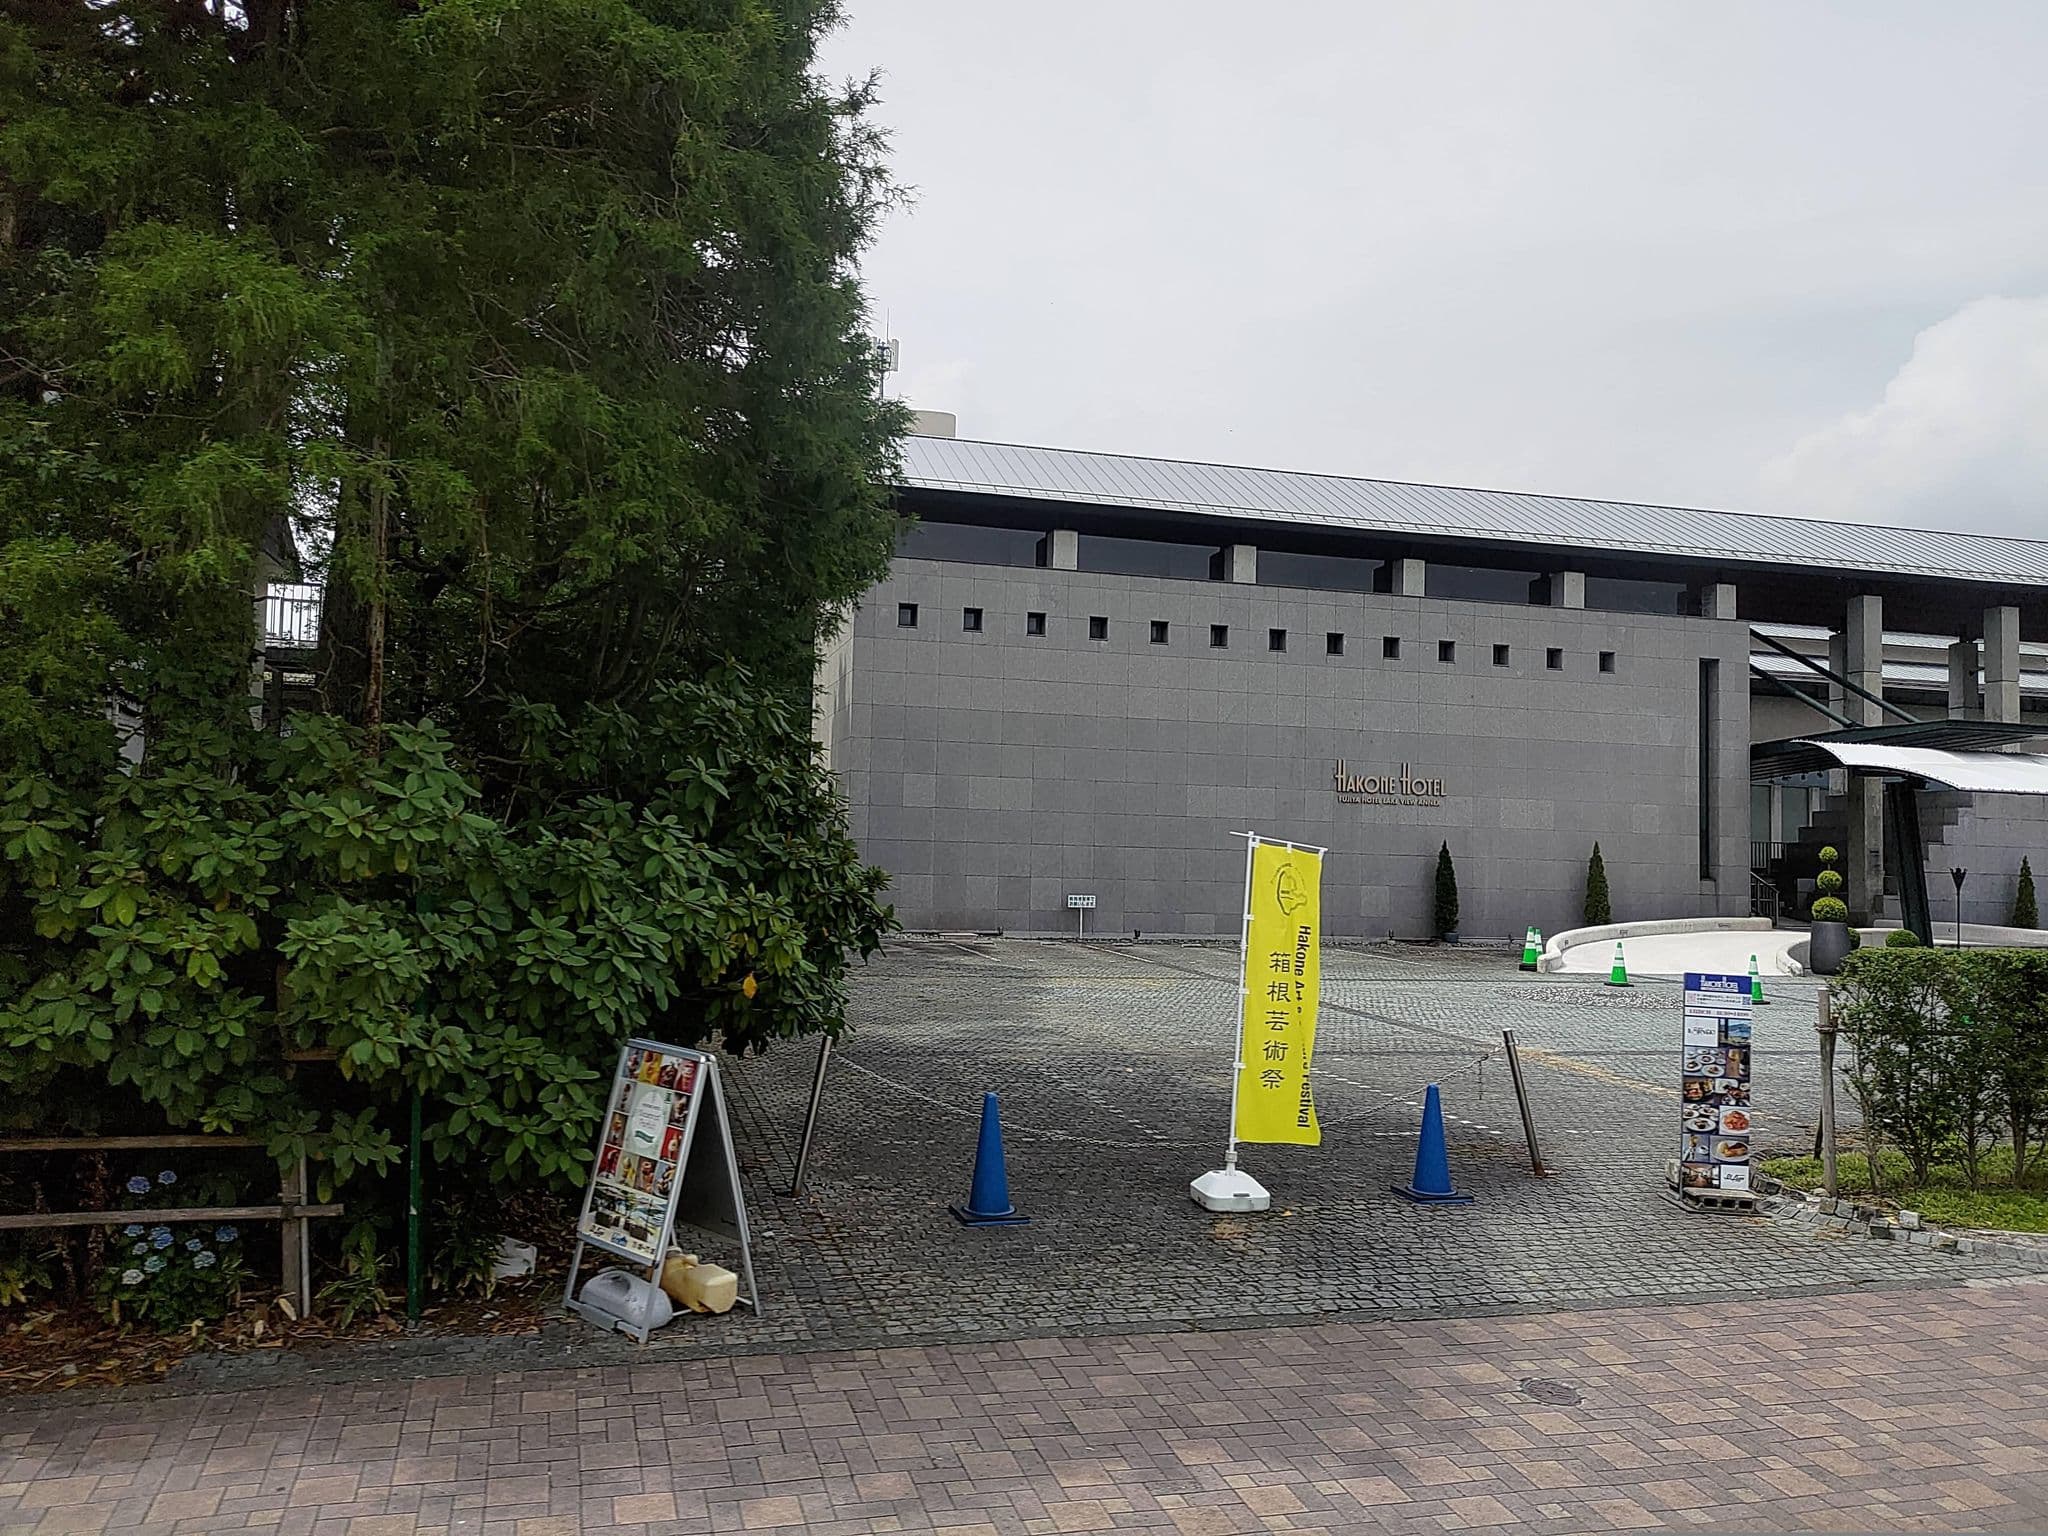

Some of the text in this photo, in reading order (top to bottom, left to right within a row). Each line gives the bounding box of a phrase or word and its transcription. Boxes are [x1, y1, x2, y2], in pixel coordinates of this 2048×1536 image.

[1335, 759, 1447, 797] HAKONE HOTEL
[1295, 925, 1311, 977] Hakone
[1260, 951, 1291, 1090] 箱根芸術祭
